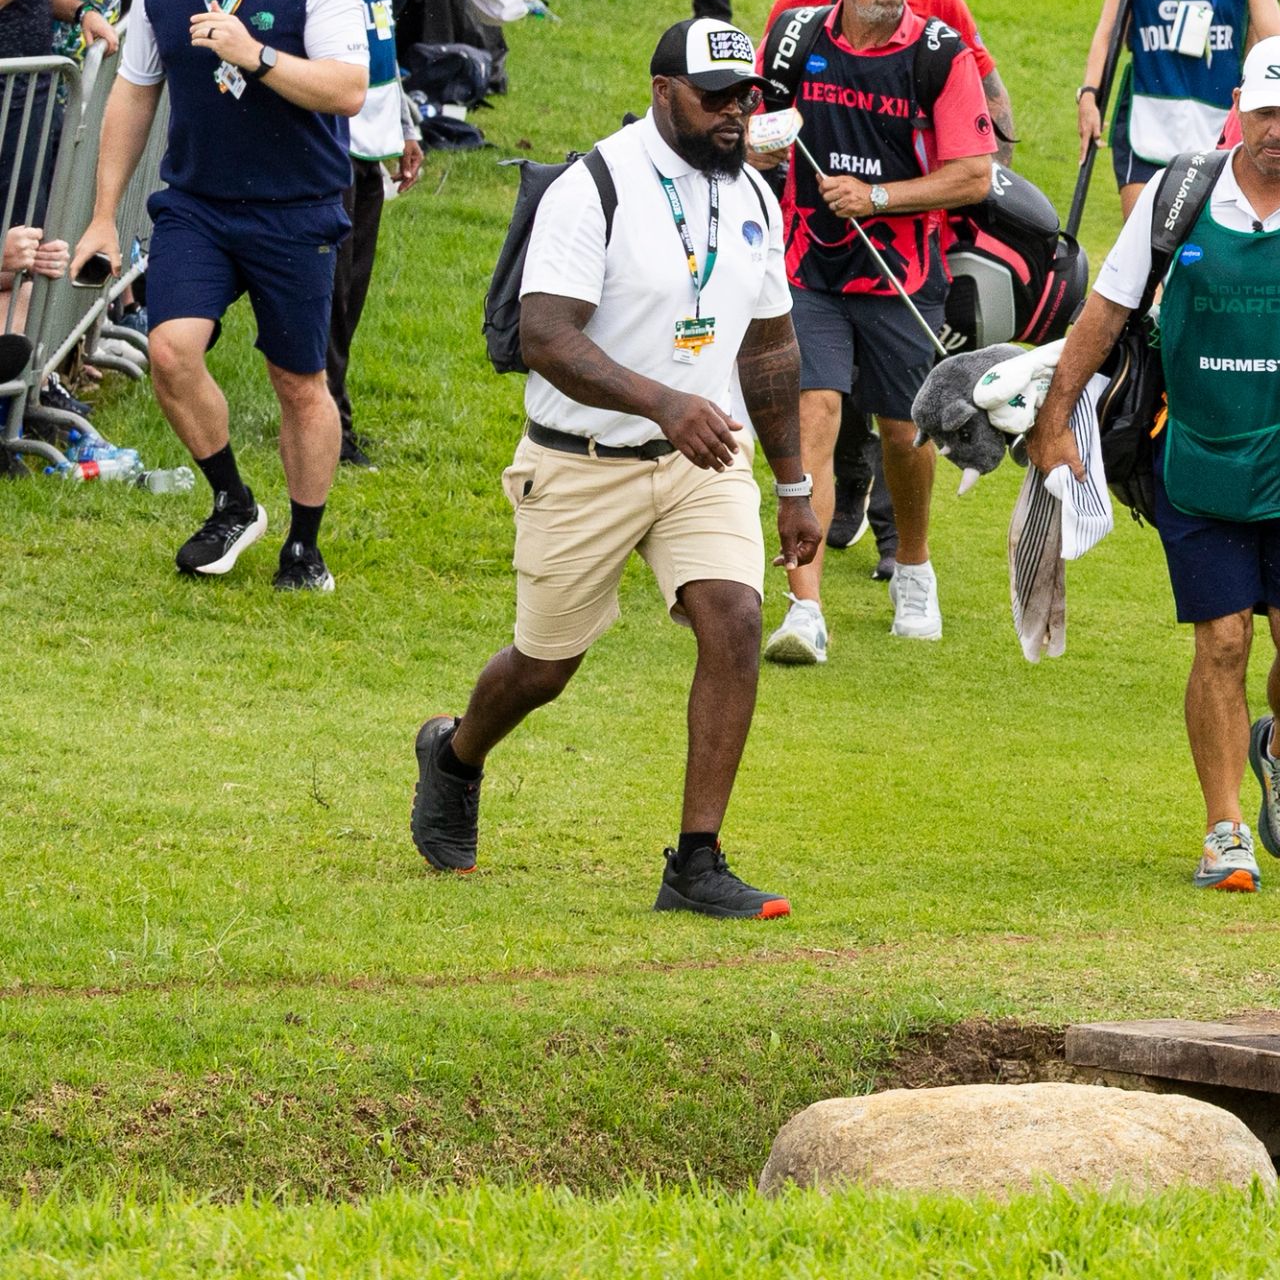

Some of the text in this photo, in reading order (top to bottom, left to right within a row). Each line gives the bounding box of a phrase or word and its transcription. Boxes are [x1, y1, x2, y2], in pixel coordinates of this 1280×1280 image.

[1139, 24, 1235, 52] VOLEER
[802, 81, 875, 111] LEGION
[829, 152, 882, 176] RAHM
[1165, 166, 1199, 232] GUARDS
